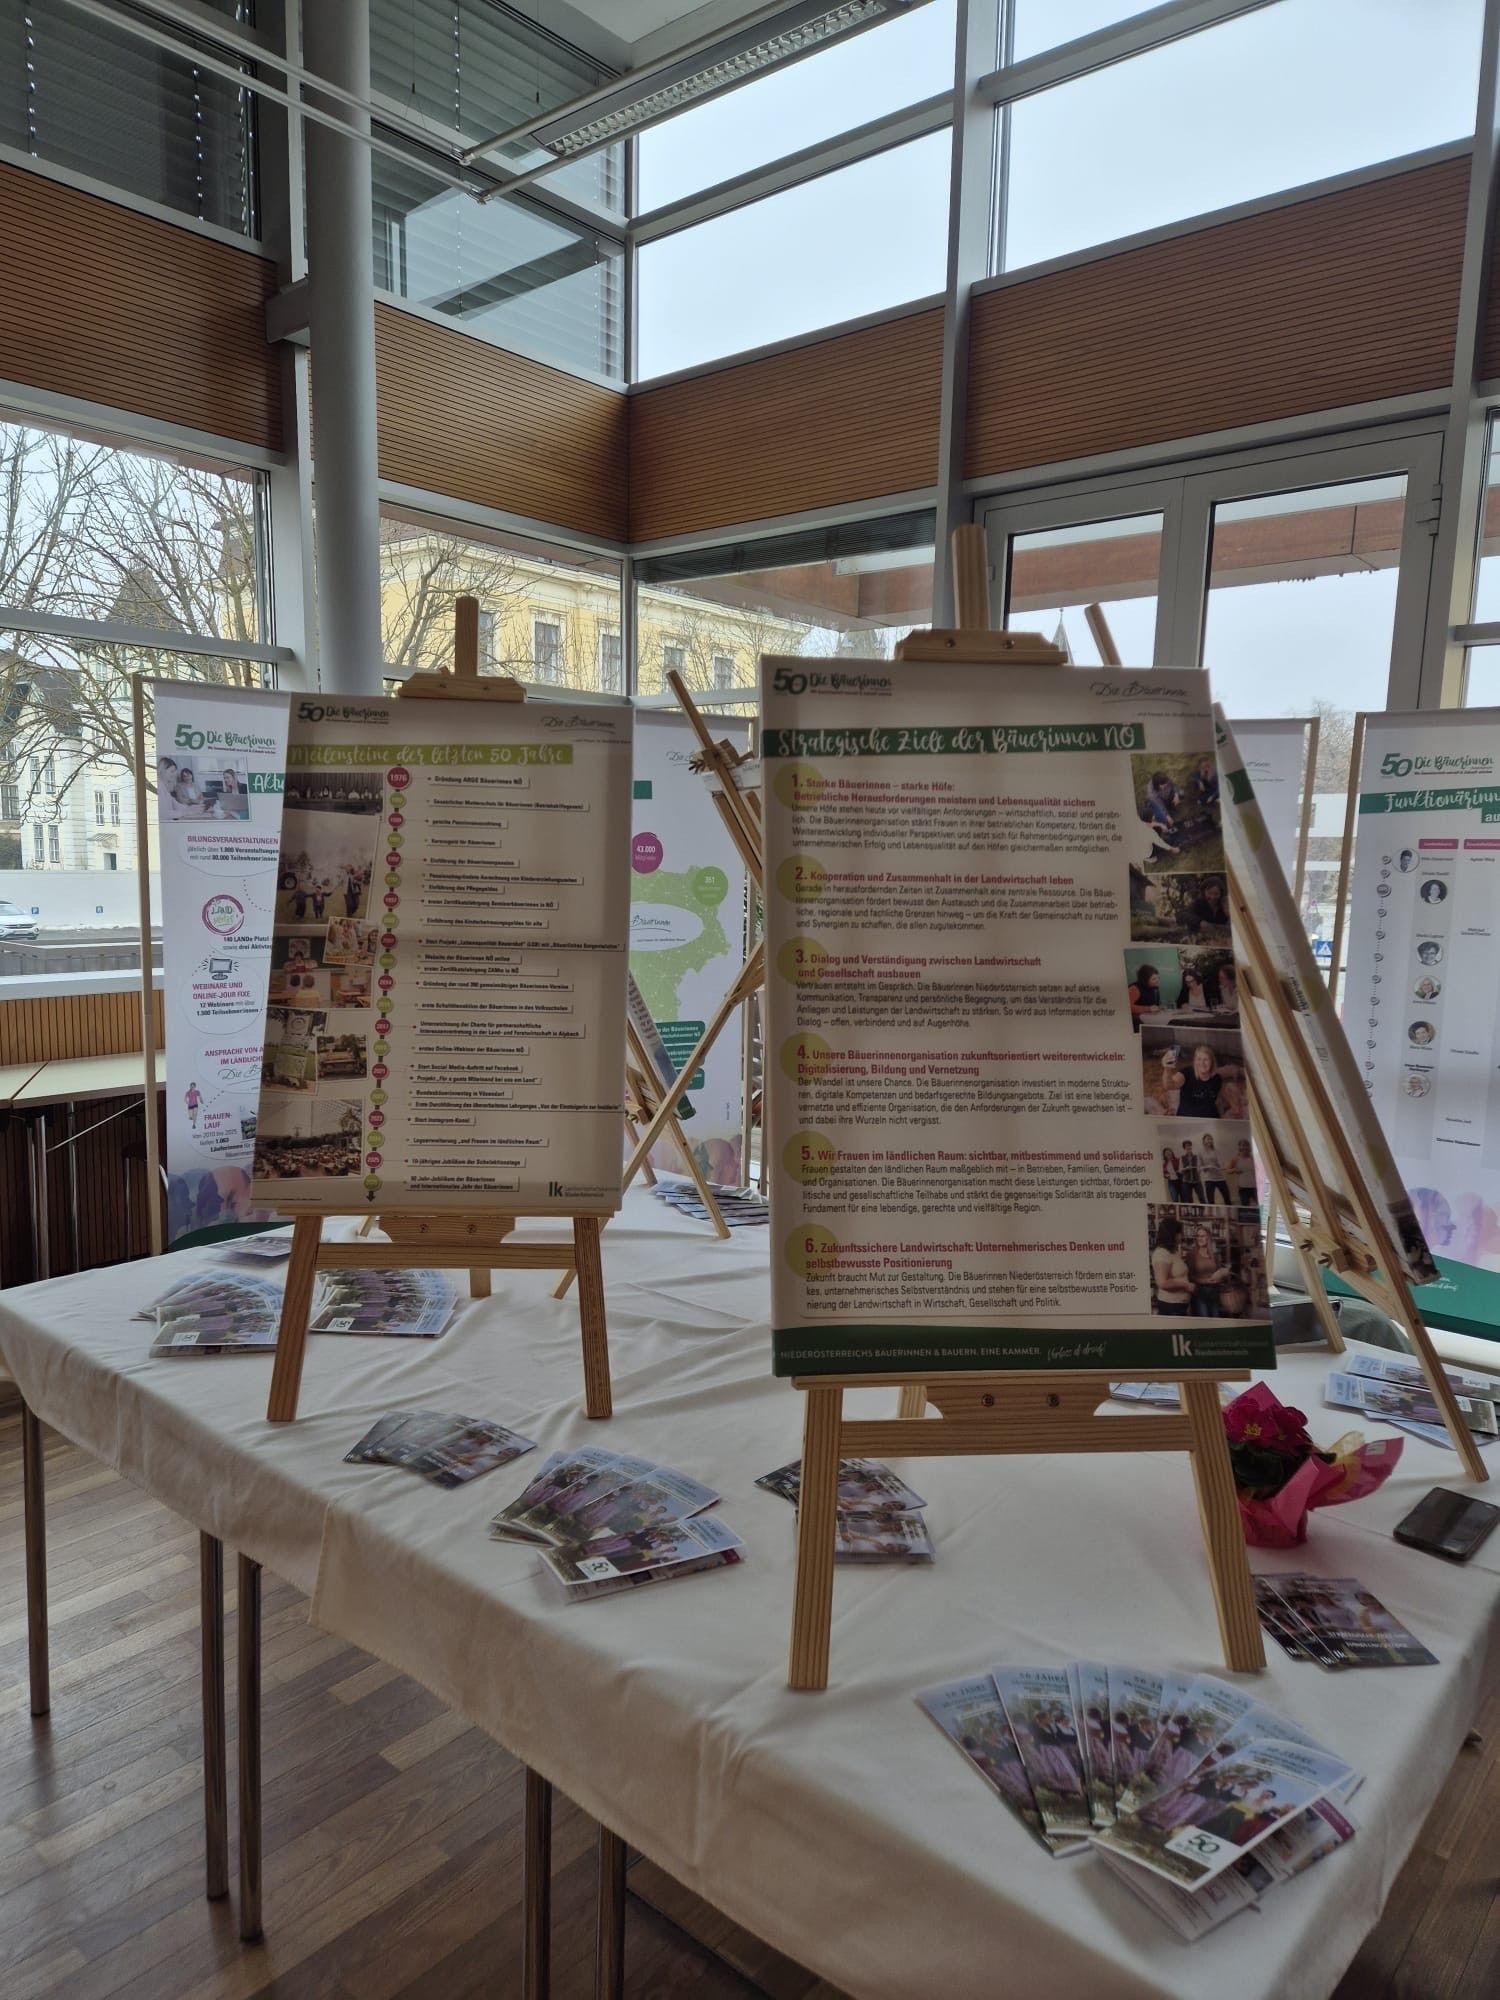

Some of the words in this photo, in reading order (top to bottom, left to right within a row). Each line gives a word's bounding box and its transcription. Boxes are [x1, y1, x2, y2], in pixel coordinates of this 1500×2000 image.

[773, 668, 807, 695] 50
[809, 672, 827, 687] Die
[297, 702, 325, 722] 50
[174, 724, 205, 750] 50
[206, 730, 223, 745] Die
[778, 728, 890, 757] Strategische
[898, 730, 945, 753] Ziele
[951, 727, 985, 753] der
[991, 725, 1099, 753] Bäuerinnen
[1104, 722, 1134, 749] NÖ
[490, 748, 511, 762] 50
[1380, 753, 1413, 777] 50
[1414, 756, 1431, 769] Die
[390, 774, 407, 782] 1976
[806, 778, 836, 788] Starke
[839, 778, 890, 790] Bäuerinnen
[901, 780, 929, 791] starke
[794, 792, 849, 804] Betriebliche
[851, 794, 935, 806] Herausforderungen
[938, 795, 976, 807] meistern
[979, 795, 994, 807] und
[997, 796, 1061, 808] Lebensqualität
[1064, 797, 1095, 809] sichern
[795, 867, 807, 880] 2.
[810, 872, 864, 884] Kooperation
[867, 872, 884, 882] und
[886, 873, 951, 883] Zusammenhalt
[953, 874, 962, 883] in
[964, 875, 978, 884] der
[981, 875, 1047, 885] Landwirtschaft
[1050, 876, 1074, 885] leben
[795, 950, 807, 964] 3.
[810, 954, 840, 965] Dialog
[842, 954, 859, 964] und
[861, 955, 927, 967] Verständigung
[929, 955, 972, 965] zwischen
[974, 956, 1041, 966] Landwirtschaft
[798, 968, 815, 977] und
[817, 968, 874, 978] Gesellschaft
[877, 968, 921, 978] ausbauen
[193, 992, 236, 1000] ONLINE-JOUR
[205, 1048, 243, 1056] ANSPRACHE
[797, 1045, 809, 1059] 4.
[812, 1050, 846, 1060] Unsere
[848, 1050, 958, 1062] Bäuerinnenorganisation
[960, 1051, 1040, 1061] zukunftsorientiert
[1042, 1051, 1125, 1061] weiterentwickeln:
[798, 1064, 869, 1076] Digitalisierung,
[871, 1064, 906, 1076] Bildung
[909, 1064, 926, 1074] und
[928, 1064, 979, 1076] Vernetzung
[204, 1112, 232, 1120] FRAUEN-
[204, 1121, 221, 1129] LAUF
[801, 1146, 814, 1160] 5.
[817, 1151, 835, 1160] Wir
[837, 1151, 869, 1160] Frauen
[872, 1151, 883, 1160] im
[886, 1151, 935, 1160] ländlichen
[938, 1151, 966, 1160] Raum:
[969, 1151, 1008, 1161] sichtbar,
[1011, 1151, 1081, 1161] mitbestimmend
[1083, 1151, 1100, 1160] und
[1102, 1151, 1153, 1160] solidarisch
[549, 1181, 563, 1197] lk
[805, 1238, 818, 1253] 6.
[821, 1242, 897, 1253] Zukunftssichere
[900, 1242, 973, 1253] Landwirtschaft:
[976, 1241, 1067, 1252] Unternehmerisches
[1069, 1241, 1106, 1251] Denken
[1108, 1241, 1125, 1251] und
[806, 1258, 881, 1268] selbstbewusste
[884, 1258, 952, 1269] Positionierung
[806, 1272, 835, 1281] Zukunft
[837, 1272, 867, 1281] braucht
[869, 1272, 885, 1281] Mut
[887, 1272, 899, 1281] zur
[901, 1272, 944, 1281] Gestaltung.
[948, 1271, 961, 1280] Die
[963, 1271, 1007, 1280] Bäuerinnen
[1009, 1271, 1074, 1280] Niederösterreich
[1075, 1271, 1103, 1280] fördern
[1104, 1271, 1117, 1280] ein
[1119, 1271, 1136, 1280] star-
[806, 1286, 822, 1296] kes,
[824, 1286, 899, 1296] unternehmerisches
[901, 1285, 970, 1295] Selbstverständnis
[972, 1285, 986, 1295] und
[988, 1285, 1014, 1295] stehen
[1016, 1284, 1028, 1294] für
[1029, 1284, 1046, 1294] eine
[1048, 1284, 1108, 1294] selbstbewusste
[1110, 1284, 1138, 1294] Positio-
[807, 1300, 836, 1309] nierung
[839, 1300, 851, 1309] der
[854, 1299, 912, 1309] Landwirtschaft
[914, 1299, 921, 1308] in
[924, 1298, 967, 1308] Wirtschaft,
[969, 1298, 1017, 1307] Gesellschaft
[1019, 1298, 1034, 1307] und
[1036, 1297, 1060, 1307] Politik.
[1172, 1334, 1193, 1357] lk
[780, 1350, 873, 1360] NIEDERÖSTERREICHS
[875, 1348, 932, 1358] BÄUERINNEN
[980, 1348, 1001, 1356] EINE
